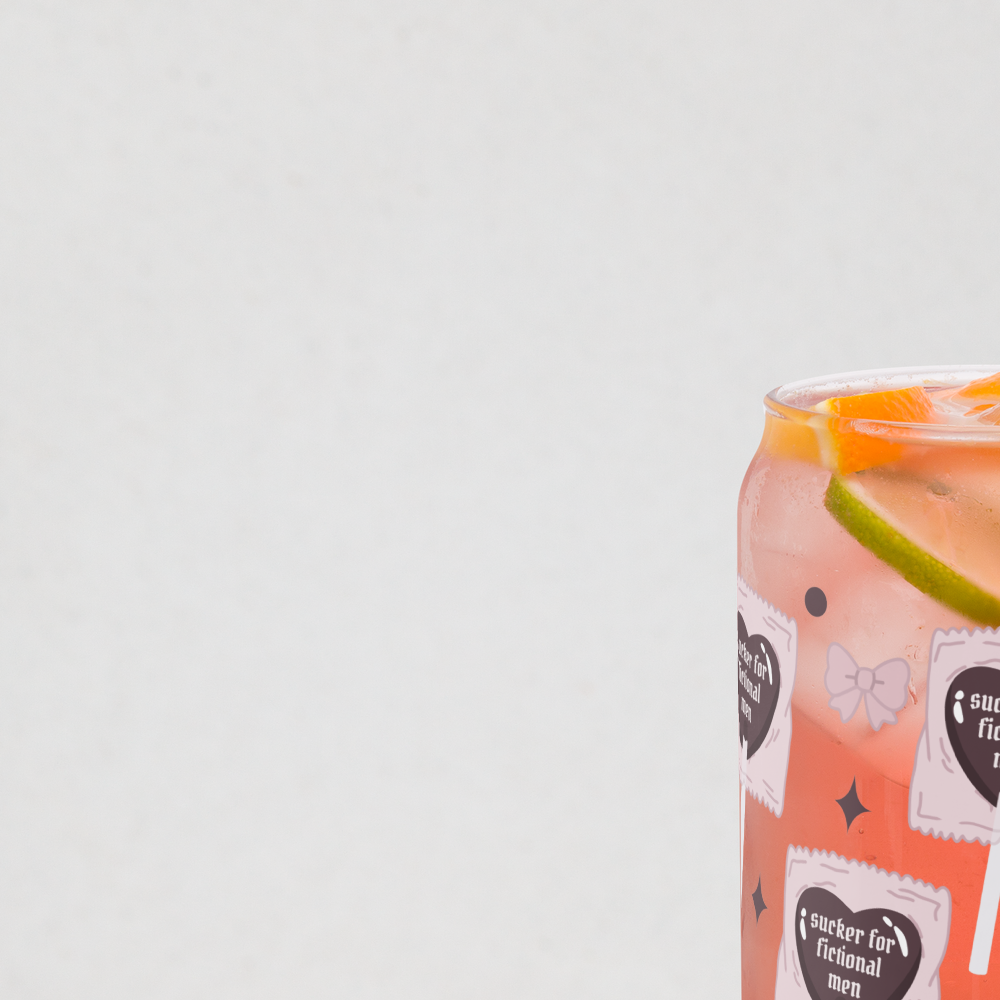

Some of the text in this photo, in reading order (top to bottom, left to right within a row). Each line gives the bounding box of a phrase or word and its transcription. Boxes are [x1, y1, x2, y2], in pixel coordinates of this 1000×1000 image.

[754, 654, 768, 680] for
[810, 913, 896, 954] sucker for
[816, 937, 882, 978] fictional
[828, 973, 861, 999] men
